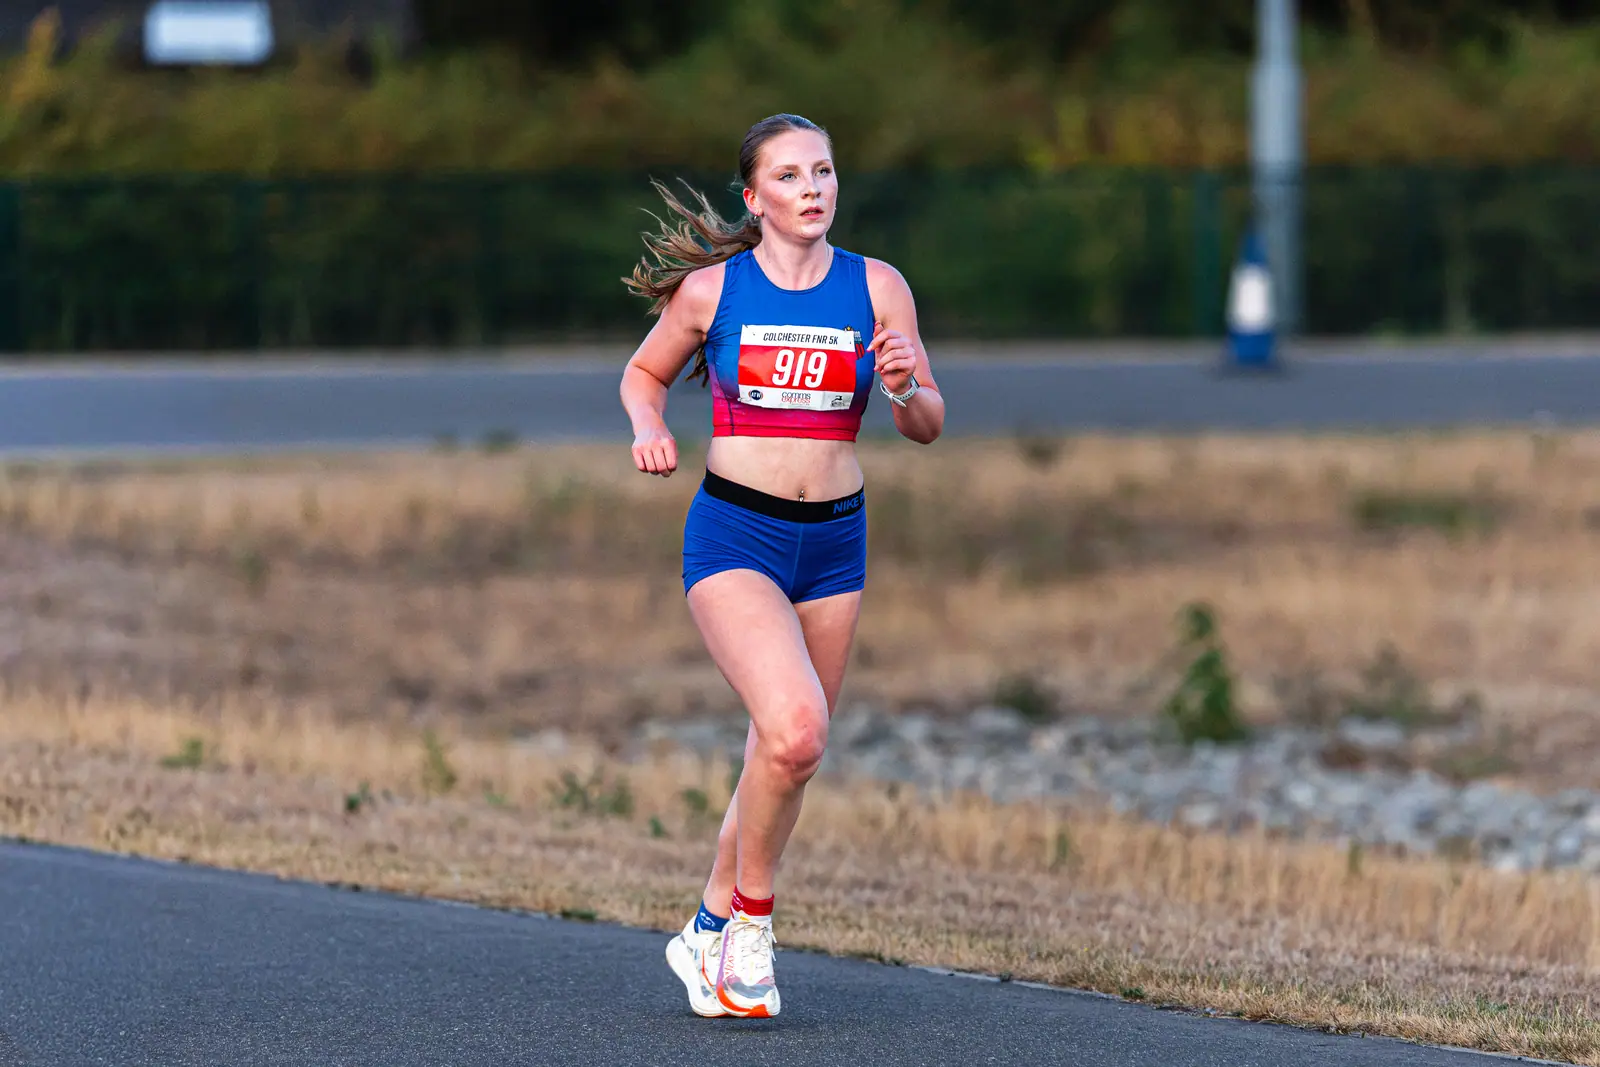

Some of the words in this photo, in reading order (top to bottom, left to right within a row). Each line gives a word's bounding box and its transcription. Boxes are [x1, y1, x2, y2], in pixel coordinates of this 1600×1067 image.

[763, 333, 810, 343] COLCHESTER
[812, 334, 827, 344] FNR
[829, 336, 838, 345] 5K
[771, 349, 828, 388] 919
[781, 391, 811, 400] comms
[833, 497, 859, 514] NIKE
